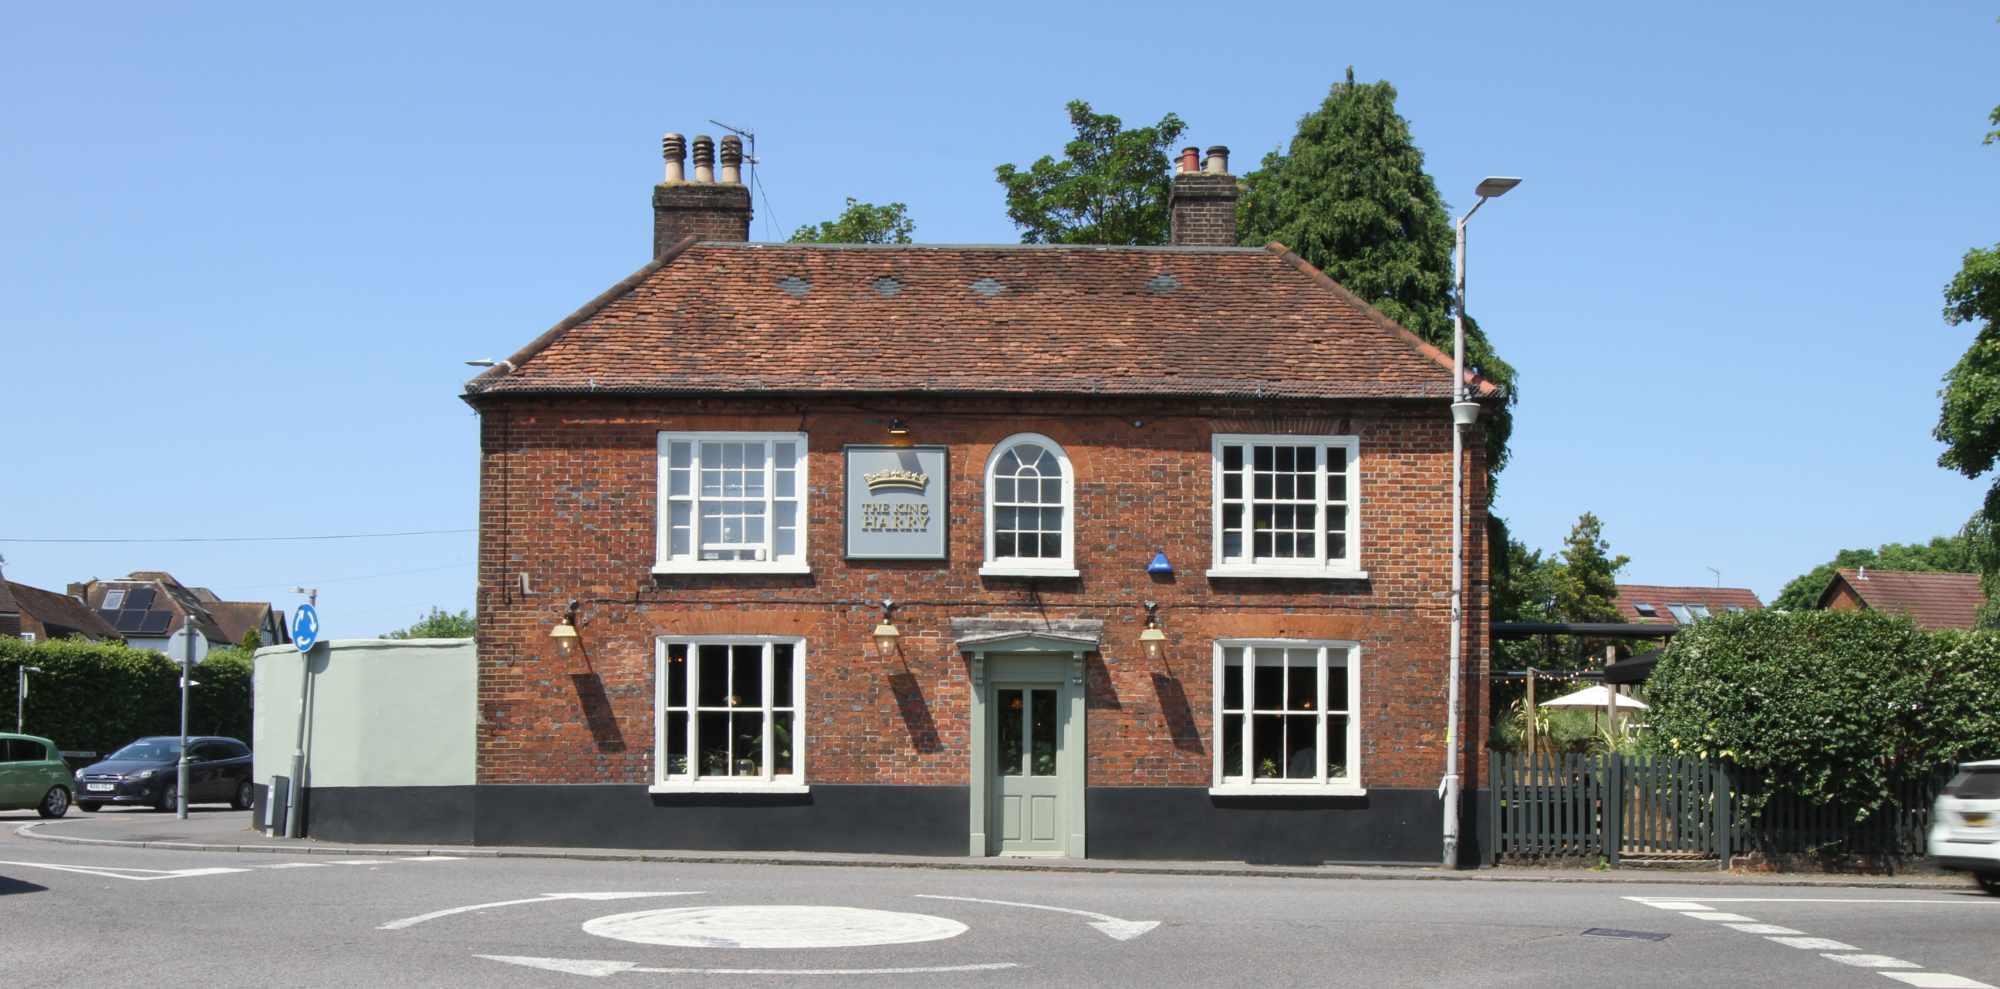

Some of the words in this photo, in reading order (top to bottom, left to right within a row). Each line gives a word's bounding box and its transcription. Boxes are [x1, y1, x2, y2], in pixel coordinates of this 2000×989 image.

[862, 503, 890, 514] THE
[895, 503, 929, 514] KING
[862, 514, 930, 531] HARRY
